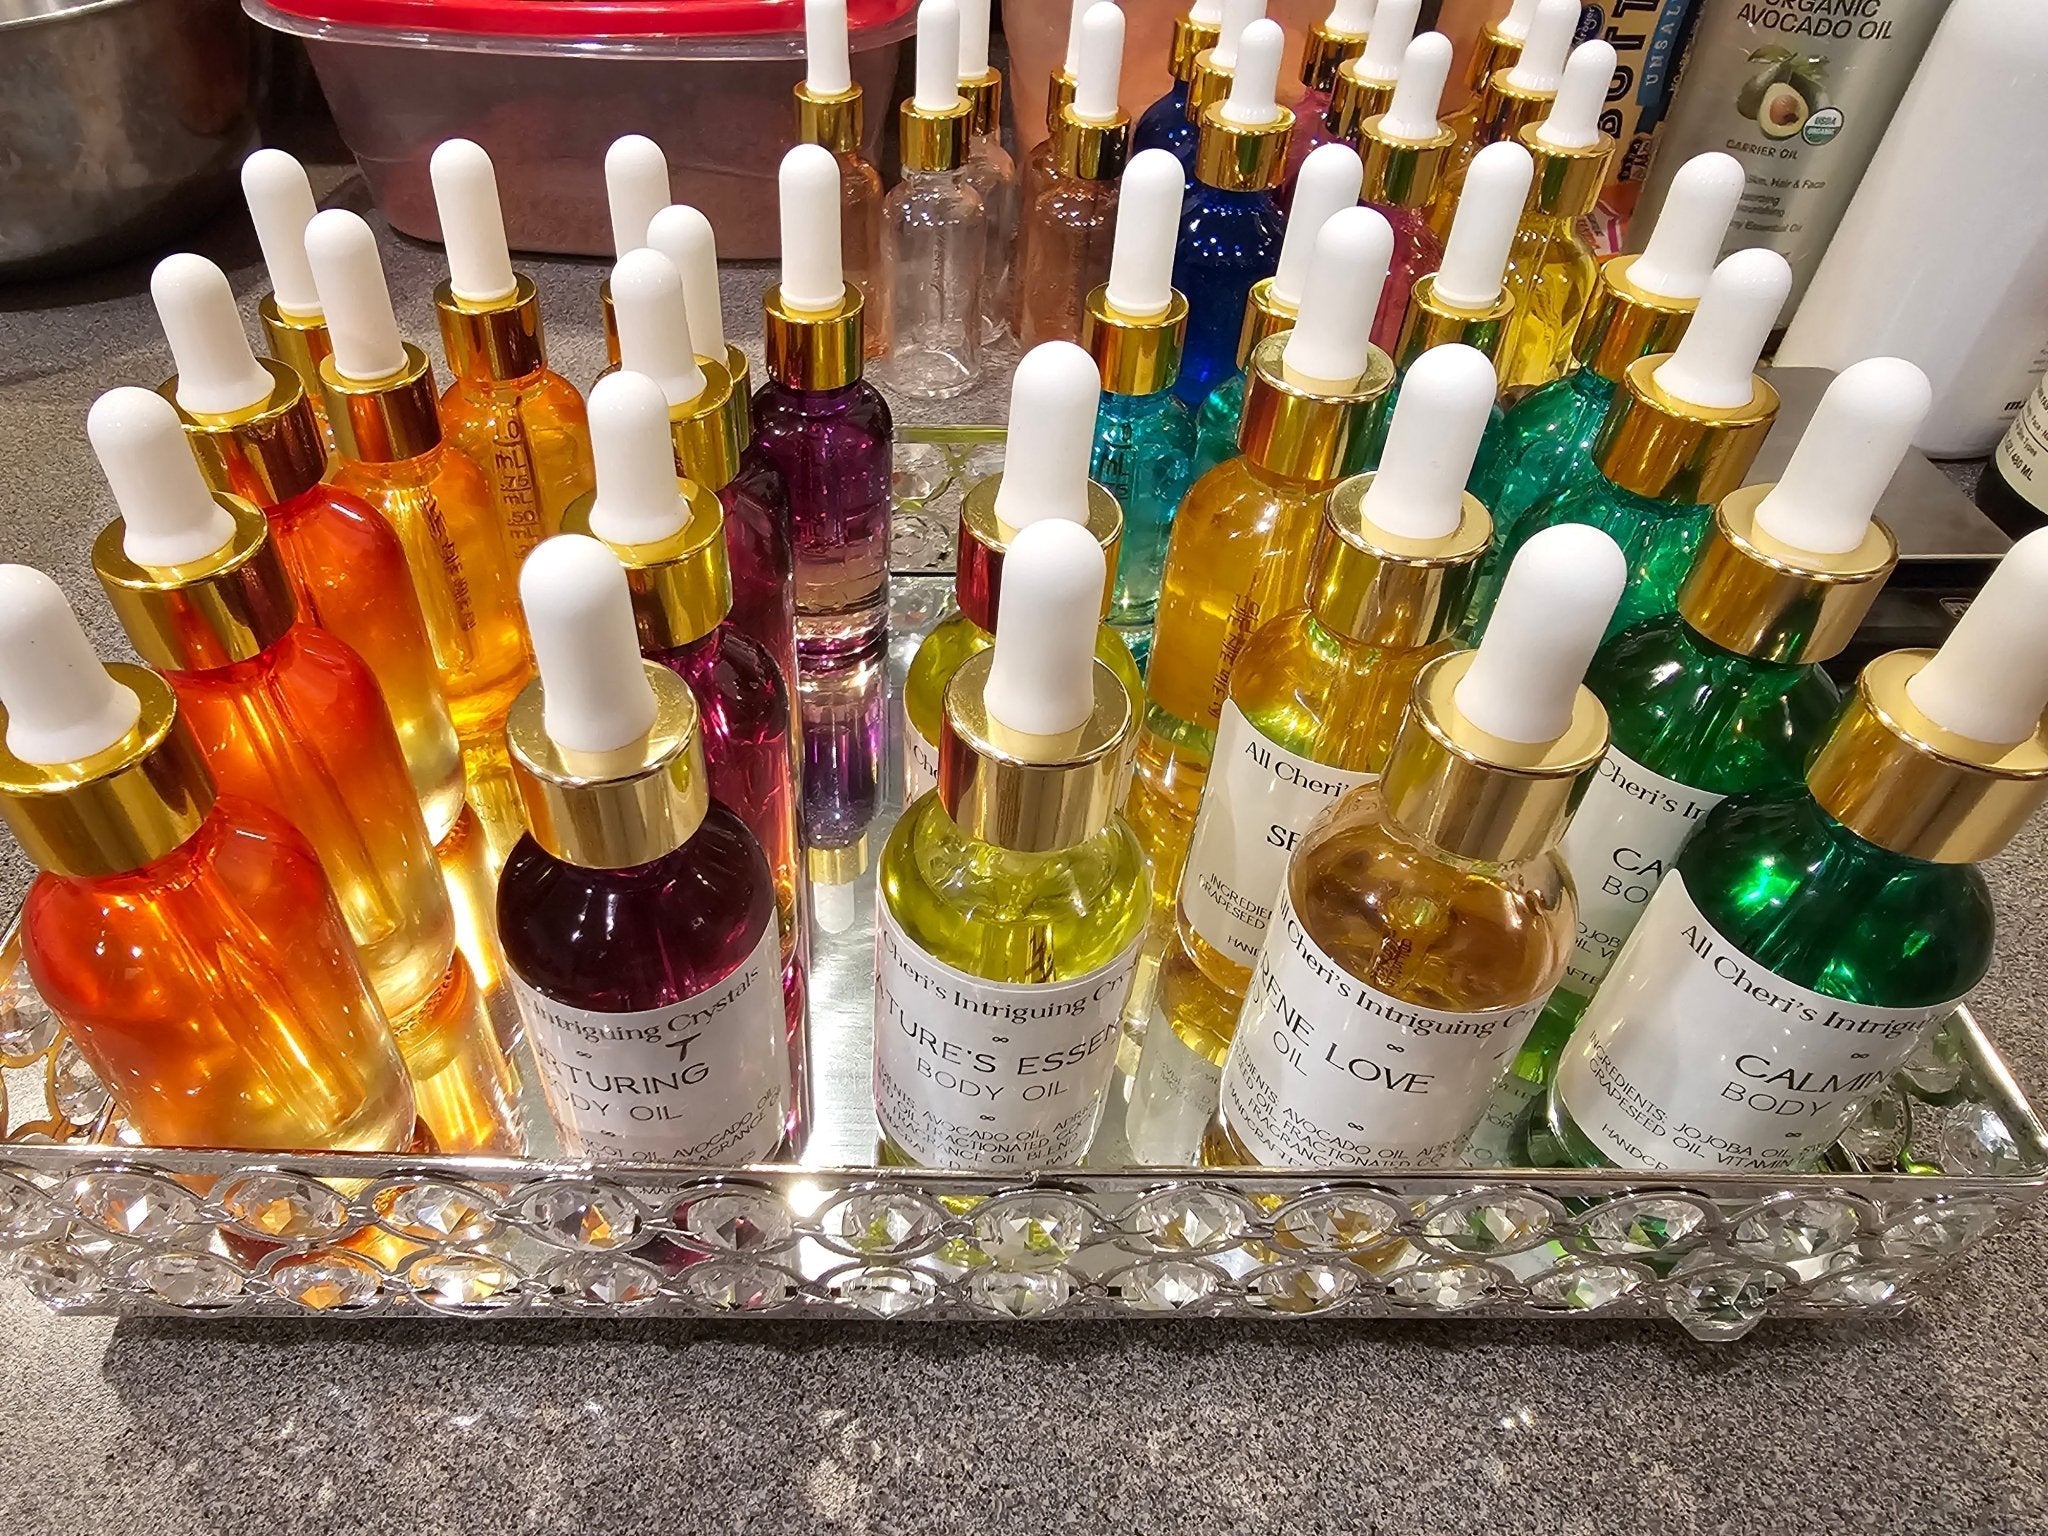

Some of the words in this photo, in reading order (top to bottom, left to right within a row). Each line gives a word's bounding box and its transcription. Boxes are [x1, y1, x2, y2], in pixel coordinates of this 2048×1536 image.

[1737, 3, 1851, 39] AVOCADO
[1857, 19, 1894, 40] OIL
[1780, 148, 1799, 160] OIL
[1245, 741, 1270, 770] All
[1600, 757, 1678, 813] Cheri's
[1613, 847, 1663, 879] CA
[884, 930, 947, 999] Cheri's
[954, 991, 1088, 1025] Intriguing
[1287, 919, 1350, 998] Cheri's
[1356, 989, 1499, 1038] Intriguing
[1681, 924, 1709, 962] All
[1714, 956, 1819, 1022] Cheri's
[667, 966, 760, 1032] Crystals
[1273, 1031, 1308, 1077] OIL
[1324, 1042, 1436, 1095] LOVE
[917, 1057, 1004, 1101] BODY
[1022, 1080, 1068, 1102] OIL
[1589, 1030, 1669, 1125] INGREDIENTS:
[1720, 1081, 1833, 1118] BODY
[629, 1105, 684, 1122] OIL
[922, 1110, 1010, 1142] AVOCADO
[1256, 1093, 1278, 1122] OIL
[1589, 1058, 1667, 1137] GRAPESEED
[1672, 1136, 1705, 1159] OIL
[673, 1111, 754, 1158] AVOCADO
[1282, 1106, 1372, 1156] AVOCADO
[1377, 1149, 1408, 1160] OIL
[1673, 1123, 1753, 1156] JOJOBA
[1761, 1148, 1791, 1159] OIL
